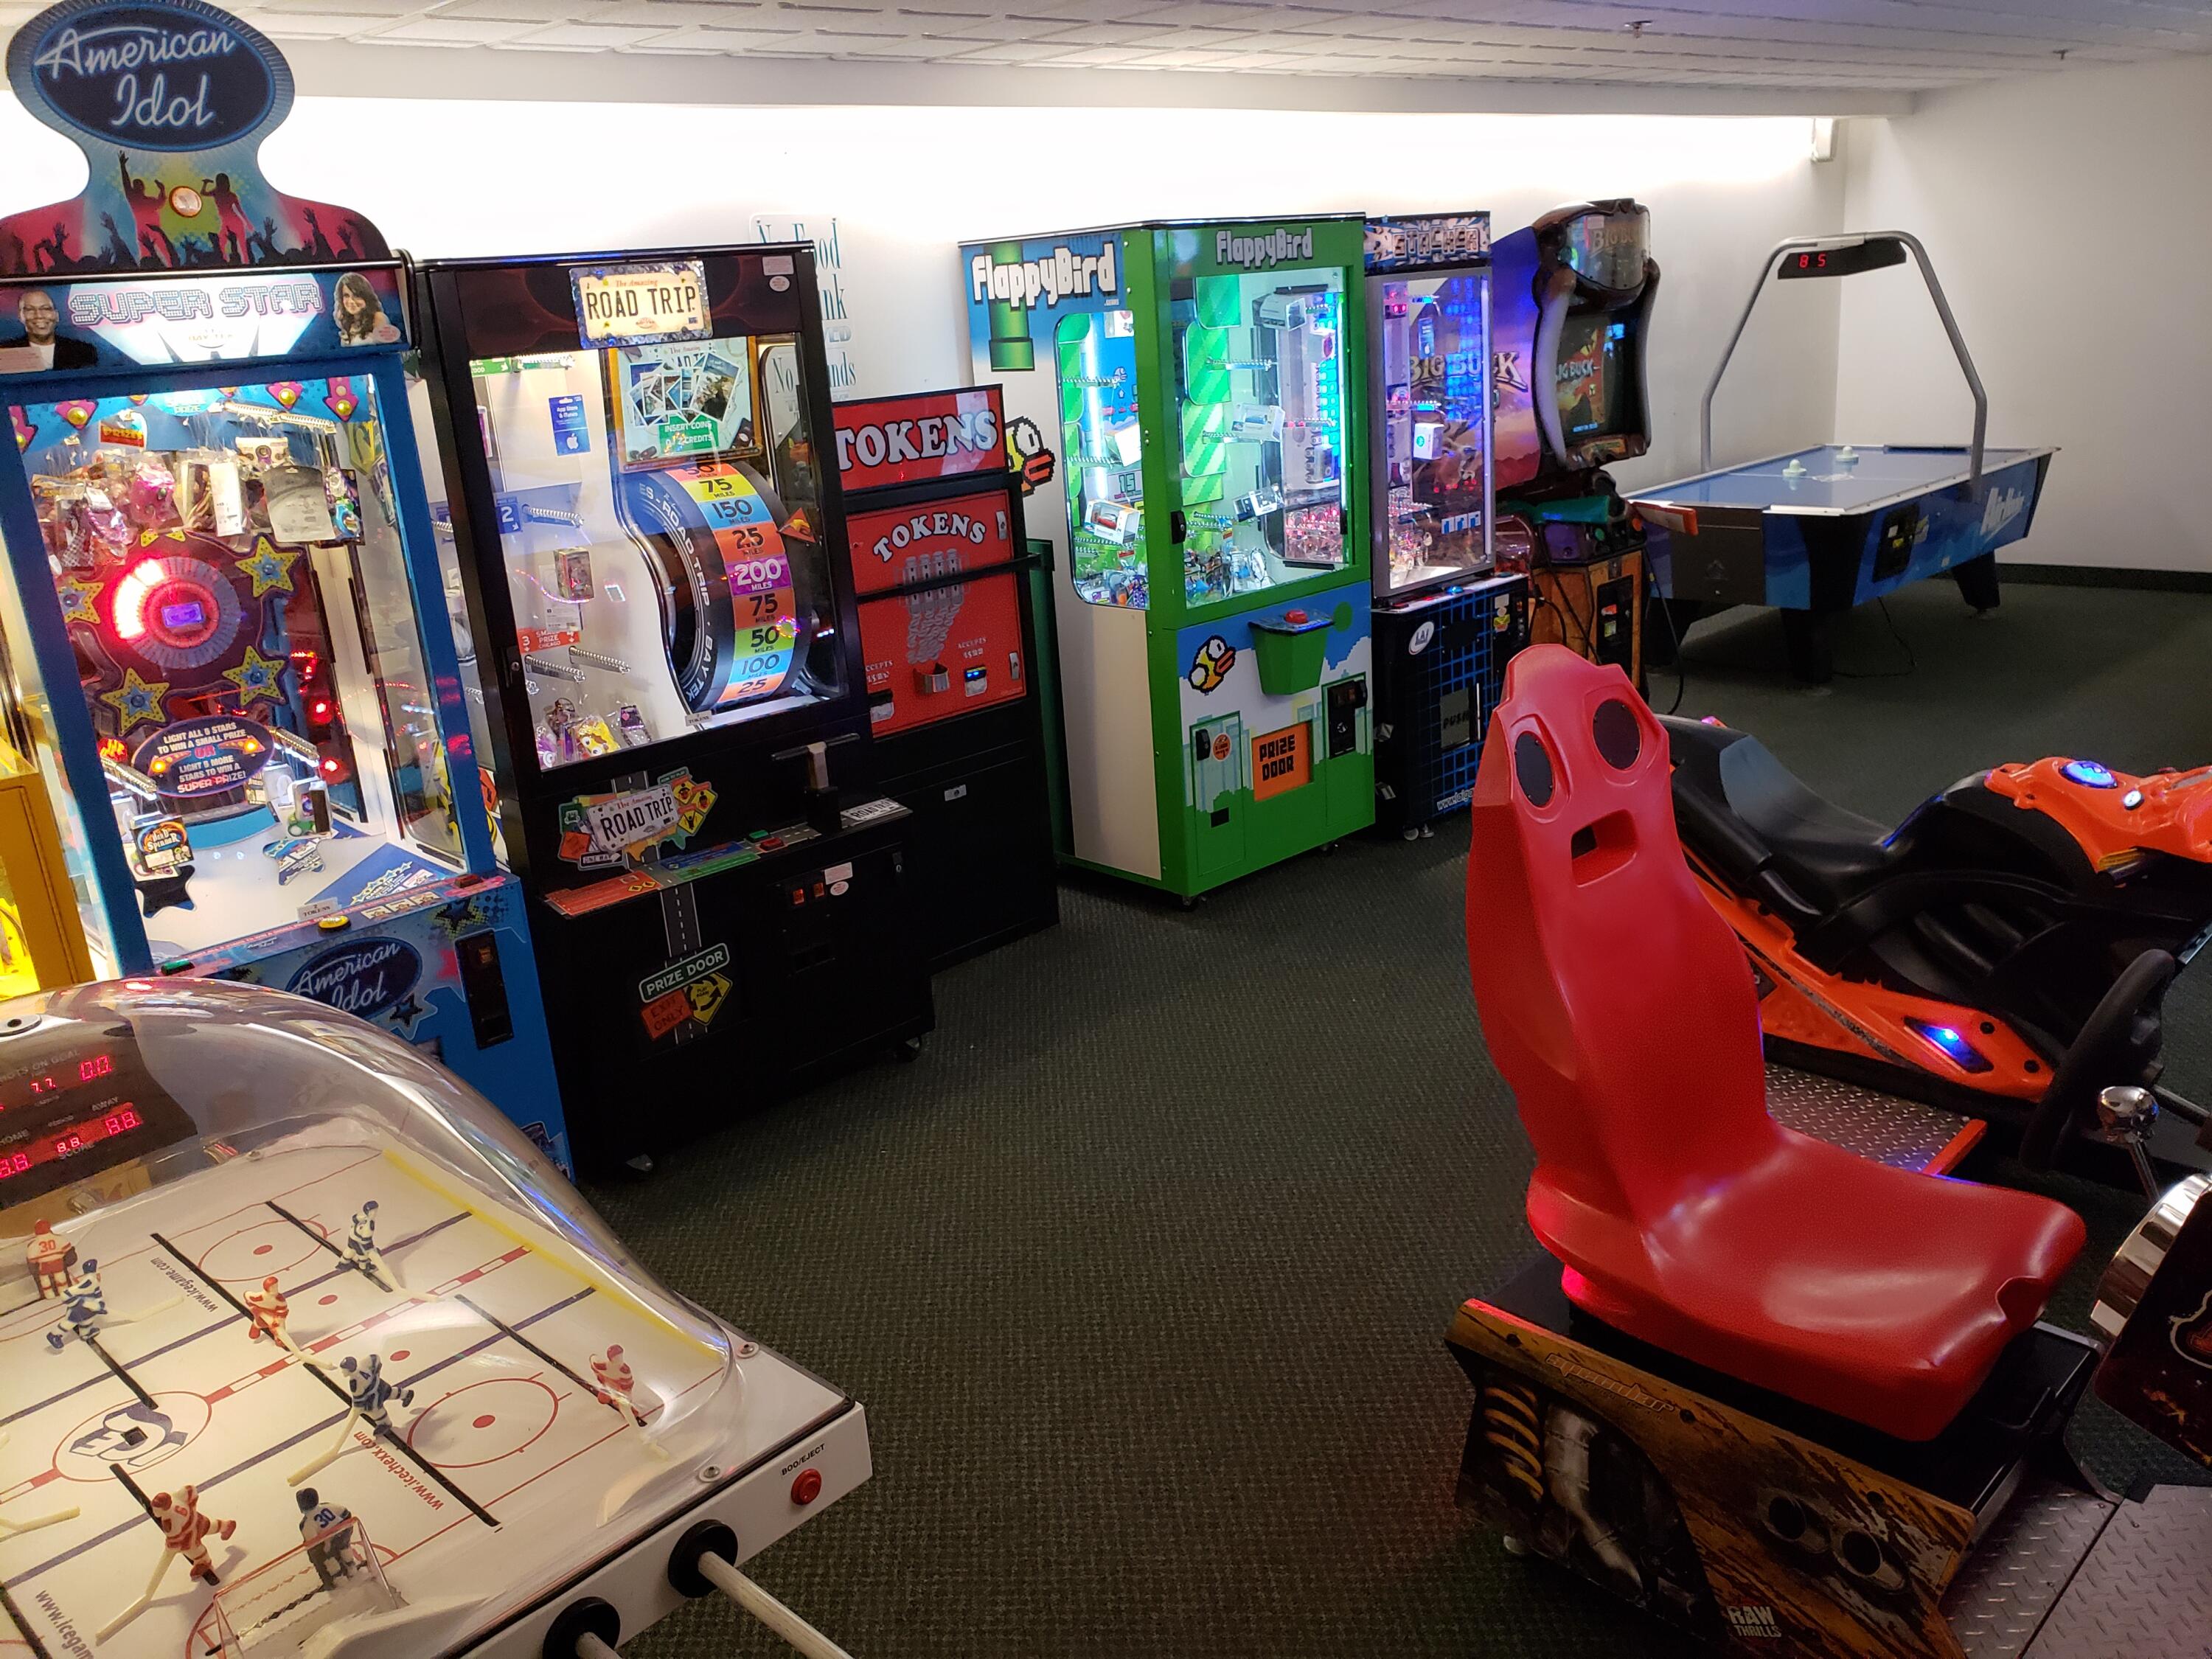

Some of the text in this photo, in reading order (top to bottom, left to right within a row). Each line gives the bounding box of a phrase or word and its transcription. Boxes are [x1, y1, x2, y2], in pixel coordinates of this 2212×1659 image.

[34, 26, 237, 80] American
[111, 74, 215, 126] Idol
[70, 283, 327, 326] SUPER STAR
[586, 286, 696, 320] ROAD TRIP
[772, 357, 794, 394] No
[1447, 351, 1528, 392] BUK
[664, 423, 689, 433] INSERT
[685, 434, 713, 444] CREDITS
[835, 410, 998, 472] TOKENS
[699, 479, 733, 493] 75
[501, 507, 515, 523] 2
[712, 500, 753, 519] 150
[728, 517, 751, 525] MILES
[662, 501, 695, 554] ROAD
[732, 528, 764, 549] 25
[873, 512, 987, 563] TOKENS
[743, 548, 764, 556] MILES
[694, 557, 710, 606] TRIP
[734, 559, 782, 585] 200
[751, 582, 773, 591] MILES
[749, 593, 779, 616] 75
[755, 615, 776, 623] MILES
[521, 636, 530, 647] 3
[538, 635, 559, 644] PRIZE
[751, 625, 779, 648] 50
[754, 645, 775, 654] MILES
[686, 635, 713, 702] BAY TEK
[742, 654, 780, 675] 100
[739, 678, 768, 694] 25
[157, 728, 246, 755] TO WIN A SMALL PRIZE
[163, 732, 187, 745] LIGHT
[188, 729, 204, 739] ALL
[212, 722, 237, 734] STARS
[194, 745, 216, 759] OR
[1259, 734, 1295, 762] PRIZE
[178, 762, 241, 783] STARS TO WIN A
[179, 762, 199, 773] LIGHT
[211, 754, 234, 767] MORE
[1262, 754, 1295, 782] DOOR
[177, 778, 212, 793] SUPER
[213, 770, 246, 787] PRIZE!
[616, 801, 630, 810] The
[850, 805, 875, 819] ROAD
[600, 796, 674, 841] ROAD TRIP
[293, 942, 401, 995] American
[646, 950, 724, 996] PRIZE DOOR
[331, 970, 388, 1011] Idol
[39, 1238, 57, 1253] 30
[150, 1256, 219, 1312] www.icegame.com
[353, 1430, 445, 1511] www.icechexx.com
[781, 1443, 827, 1476] BOO/EJECT
[313, 1507, 336, 1528] 30
[1726, 1606, 1775, 1625] RAW
[1733, 1624, 1782, 1638] THRILLS
